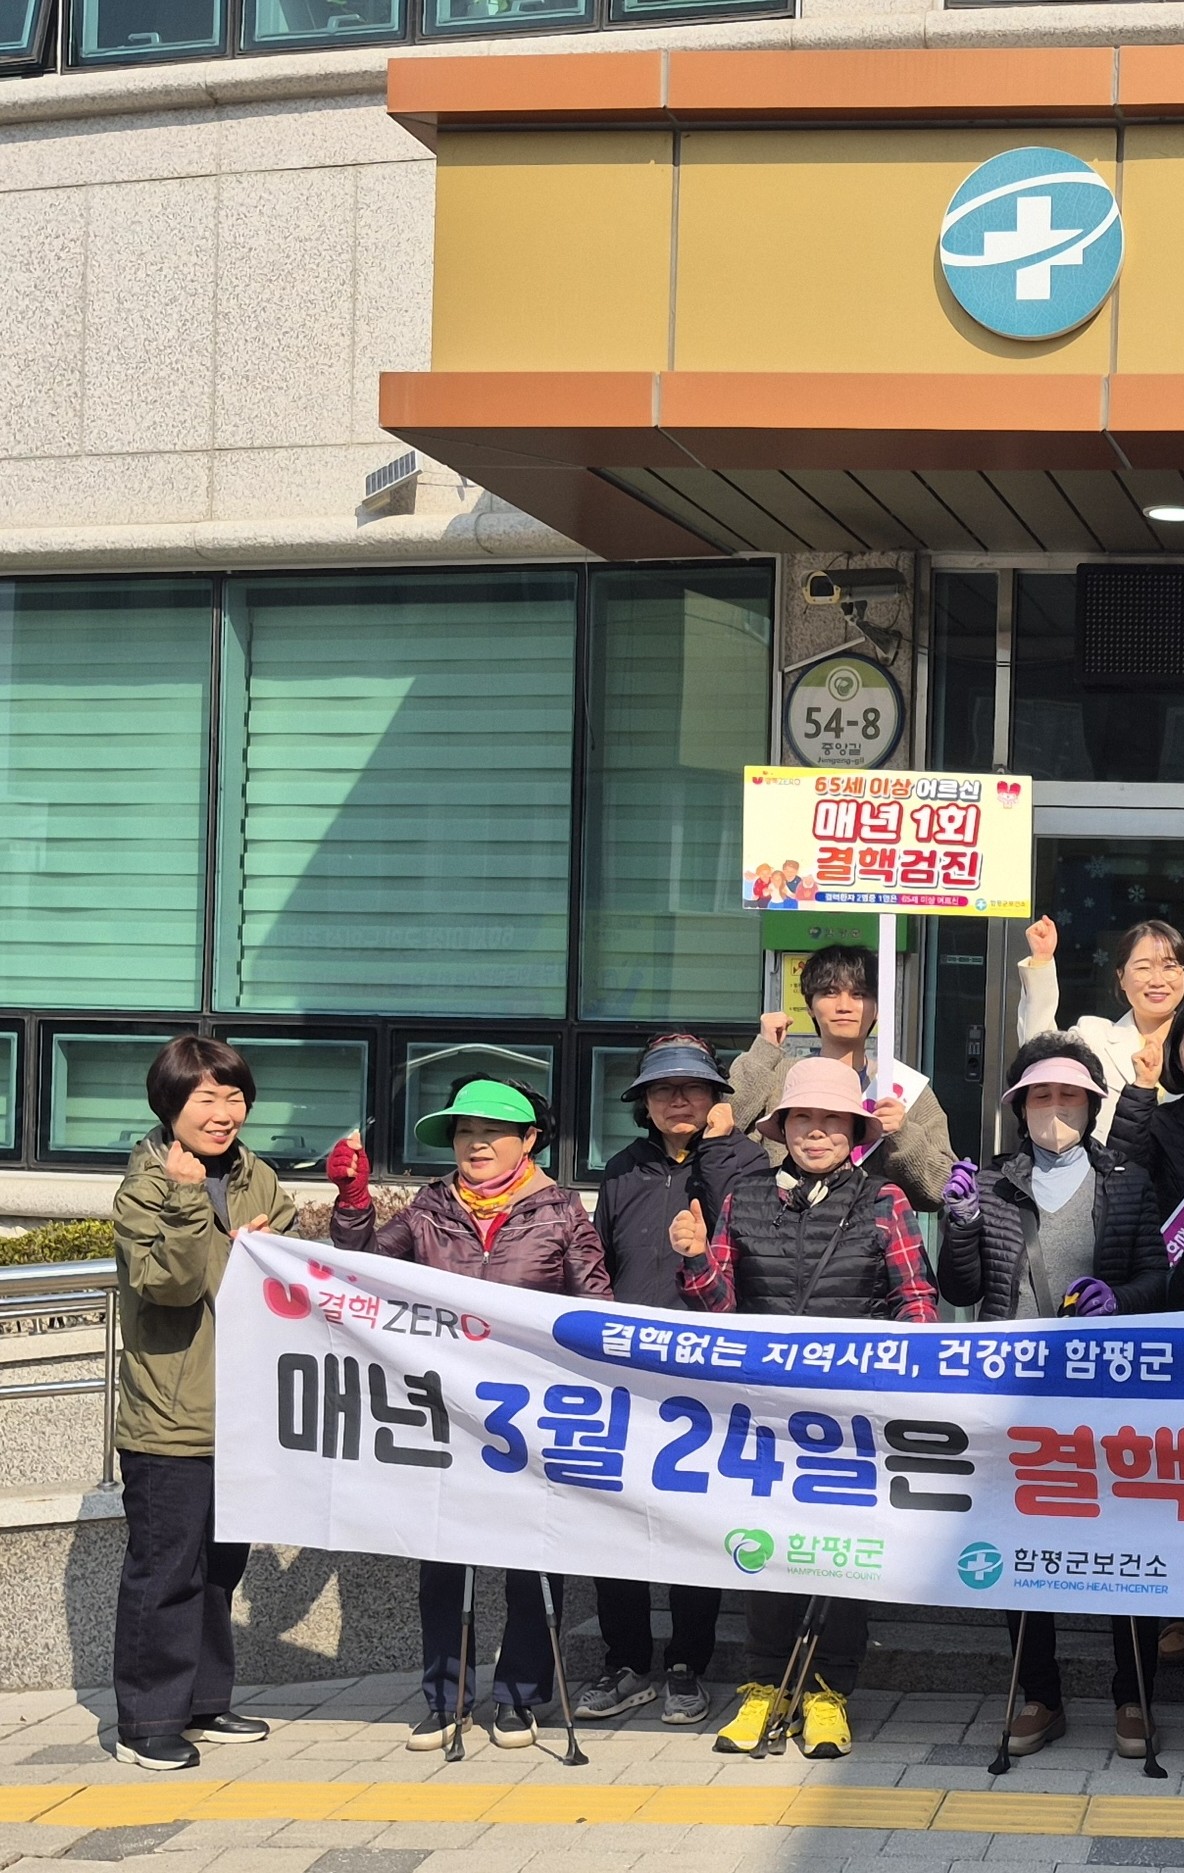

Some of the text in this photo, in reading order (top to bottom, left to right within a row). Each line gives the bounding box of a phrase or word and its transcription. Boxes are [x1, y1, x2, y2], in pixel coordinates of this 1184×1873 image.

[804, 706, 881, 740] 54-8
[821, 742, 861, 756] 중앙길
[815, 776, 981, 801] 65세 이상 어르신
[812, 799, 980, 847] 매년 1회
[815, 847, 981, 889] 결핵검진
[920, 896, 936, 904] 이상
[317, 1288, 492, 1341] 결핵ZERO
[601, 1320, 747, 1368] 결핵없는
[761, 1340, 919, 1379] 지역사회,
[938, 1338, 1049, 1380] 건강한
[1065, 1339, 1174, 1384] 함평군
[276, 1351, 453, 1469] 매년
[475, 1380, 632, 1493] 3월
[651, 1394, 975, 1513] 24일은
[786, 1532, 885, 1570] 함평군
[1013, 1547, 1169, 1579] 함평군보건소
[787, 1567, 882, 1582] HAMPYEONG COUNTY
